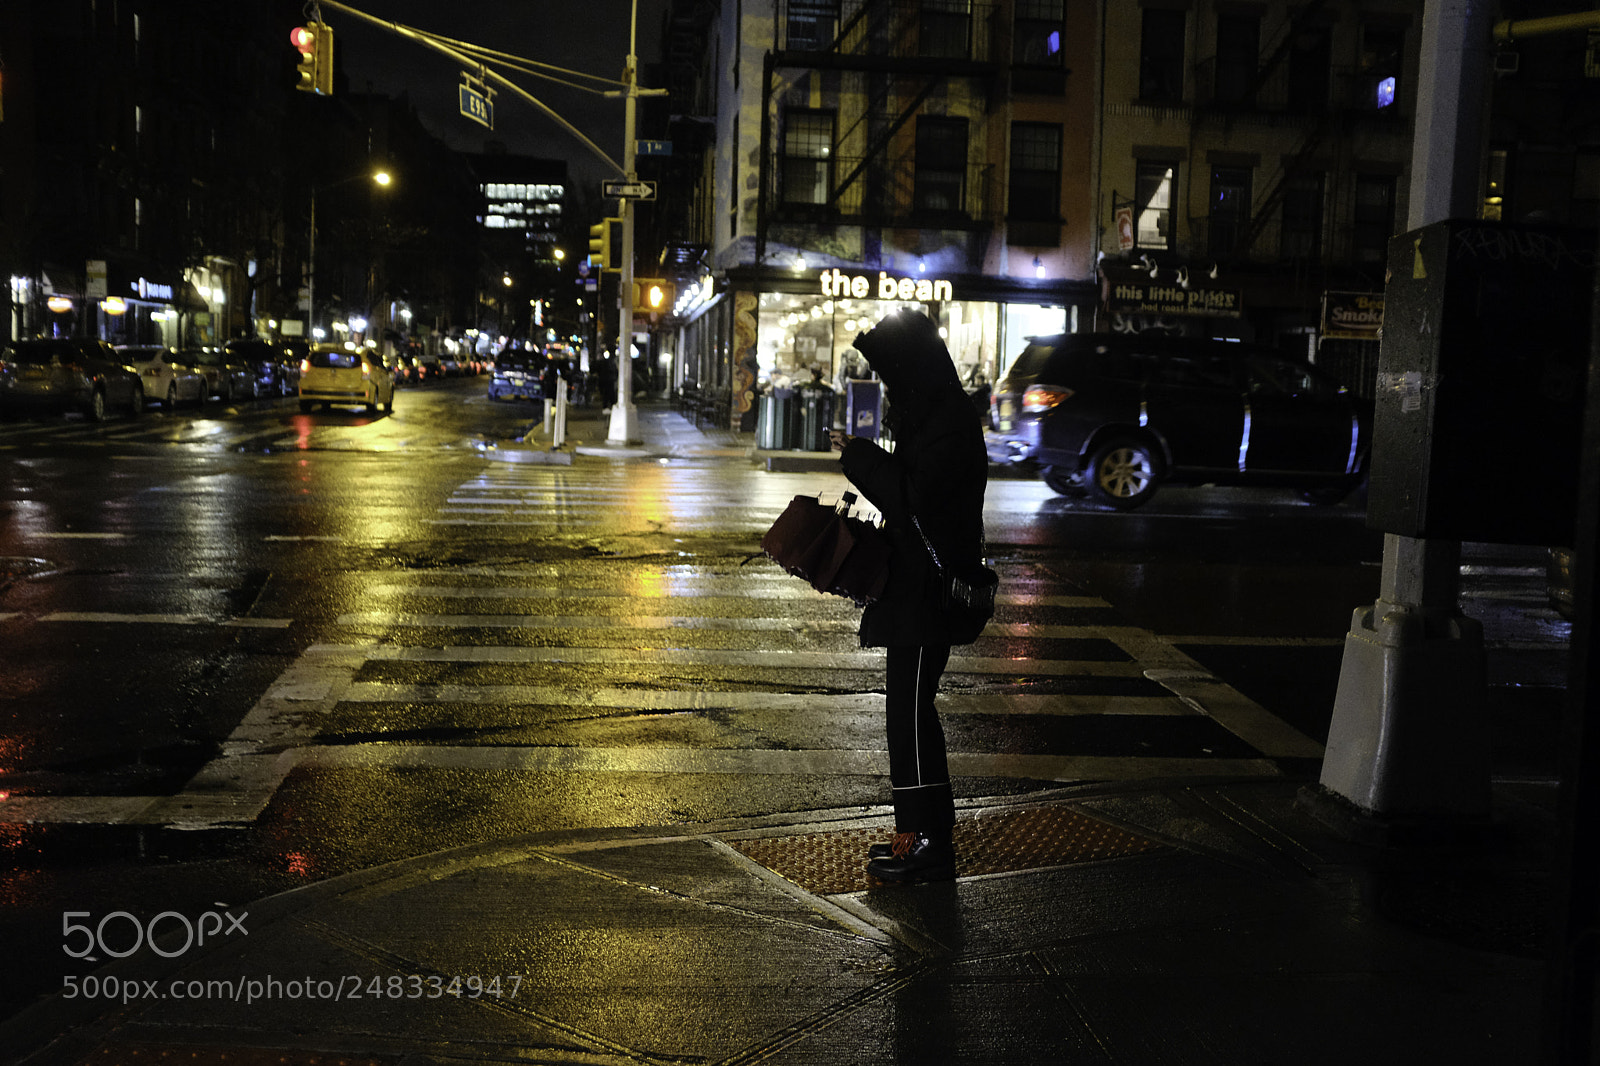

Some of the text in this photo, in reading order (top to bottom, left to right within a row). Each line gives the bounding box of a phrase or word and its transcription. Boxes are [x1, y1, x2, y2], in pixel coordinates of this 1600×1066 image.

[820, 268, 953, 301] the bean
[1115, 285, 1143, 300] this
[1149, 286, 1185, 302] little
[1141, 302, 1159, 312] had
